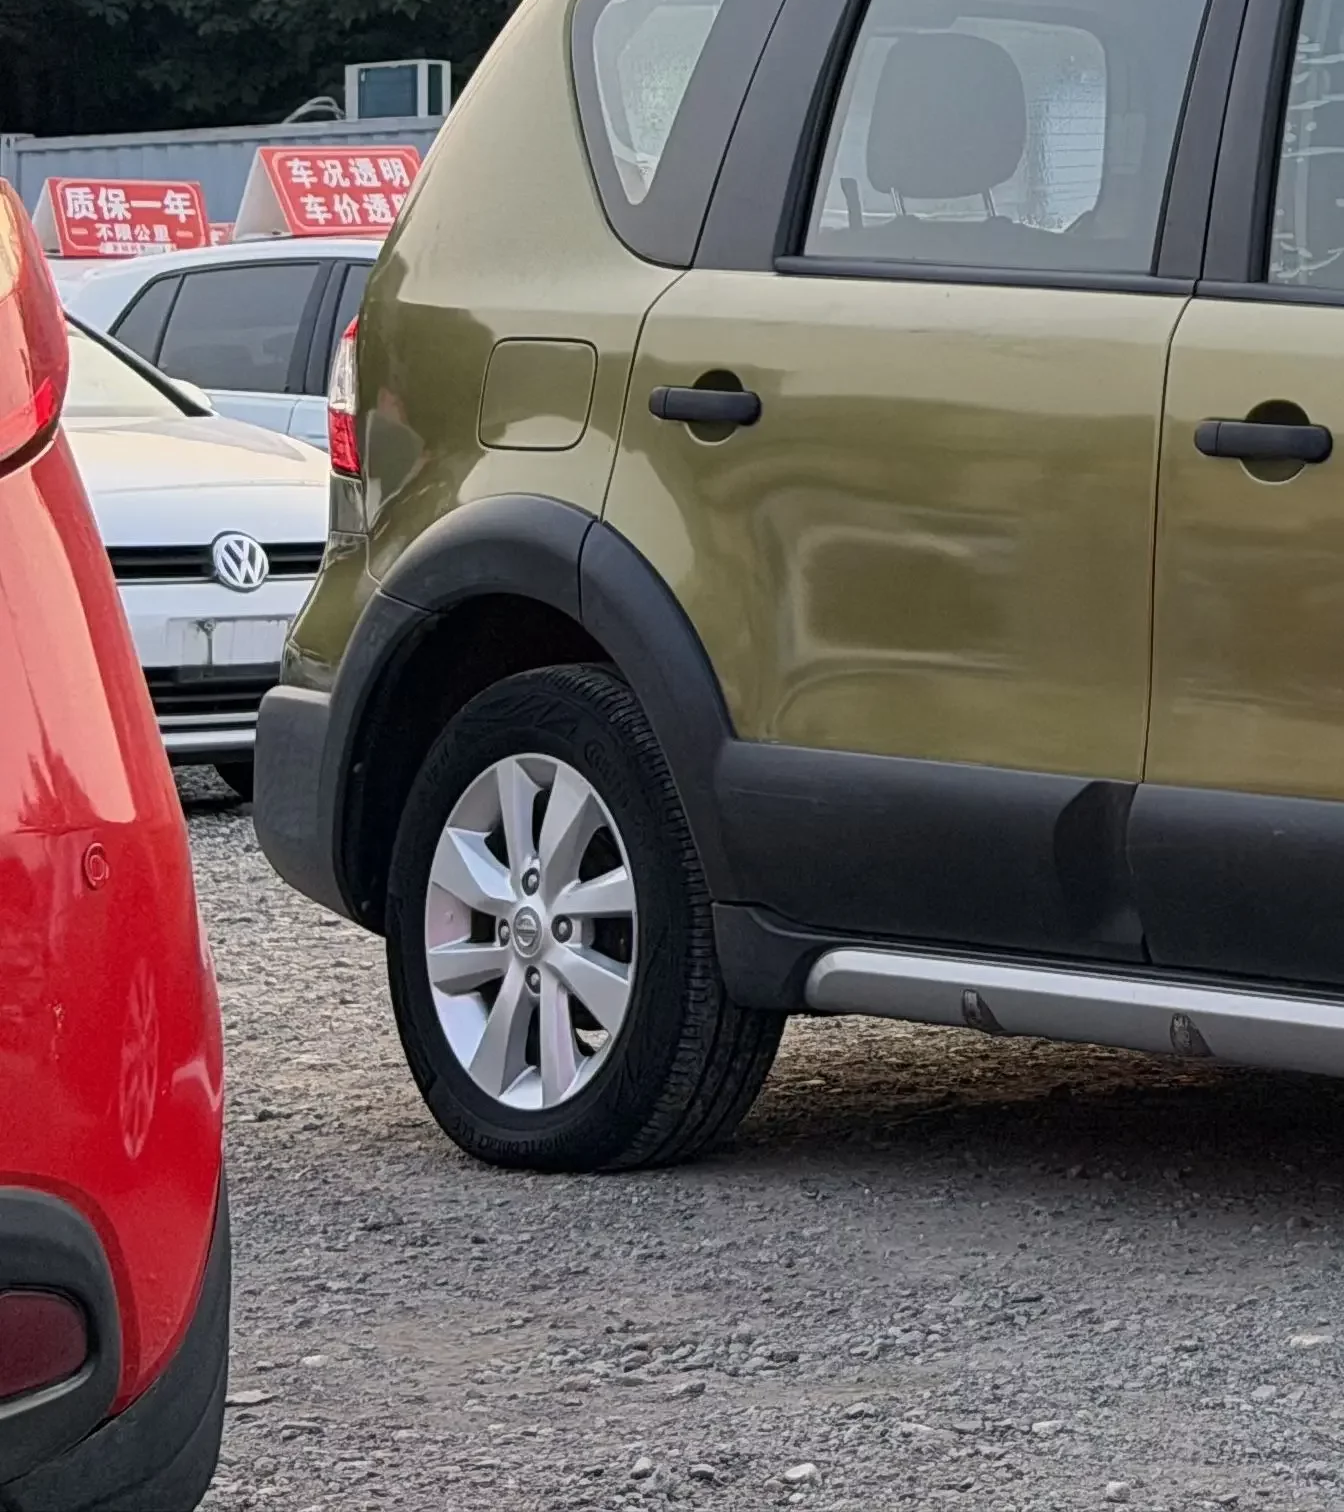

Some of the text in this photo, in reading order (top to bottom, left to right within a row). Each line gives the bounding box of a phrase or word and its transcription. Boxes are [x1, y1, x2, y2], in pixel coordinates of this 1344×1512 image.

[285, 157, 411, 188] 车况透明
[64, 186, 196, 223] 质保一年
